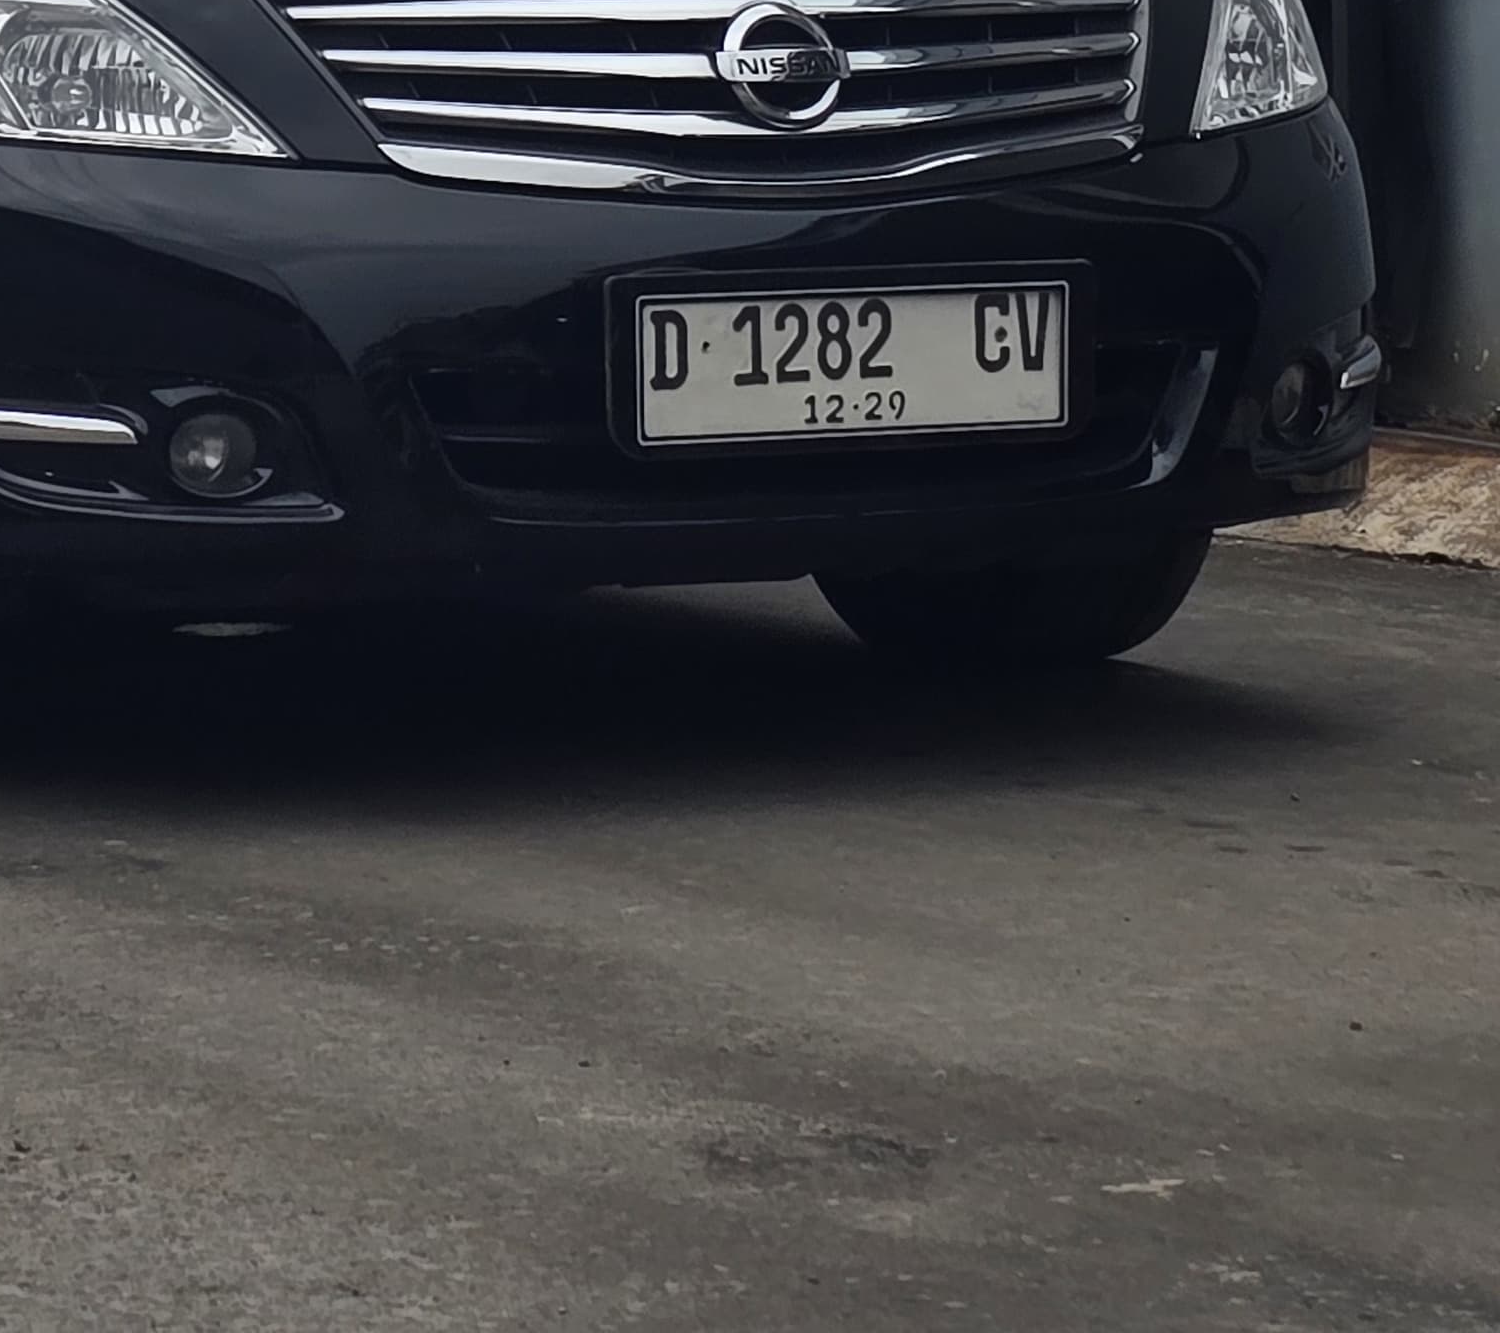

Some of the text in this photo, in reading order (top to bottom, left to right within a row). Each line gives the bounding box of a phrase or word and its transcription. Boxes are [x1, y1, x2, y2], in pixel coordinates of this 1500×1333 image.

[649, 292, 1050, 391] D 1282 CV
